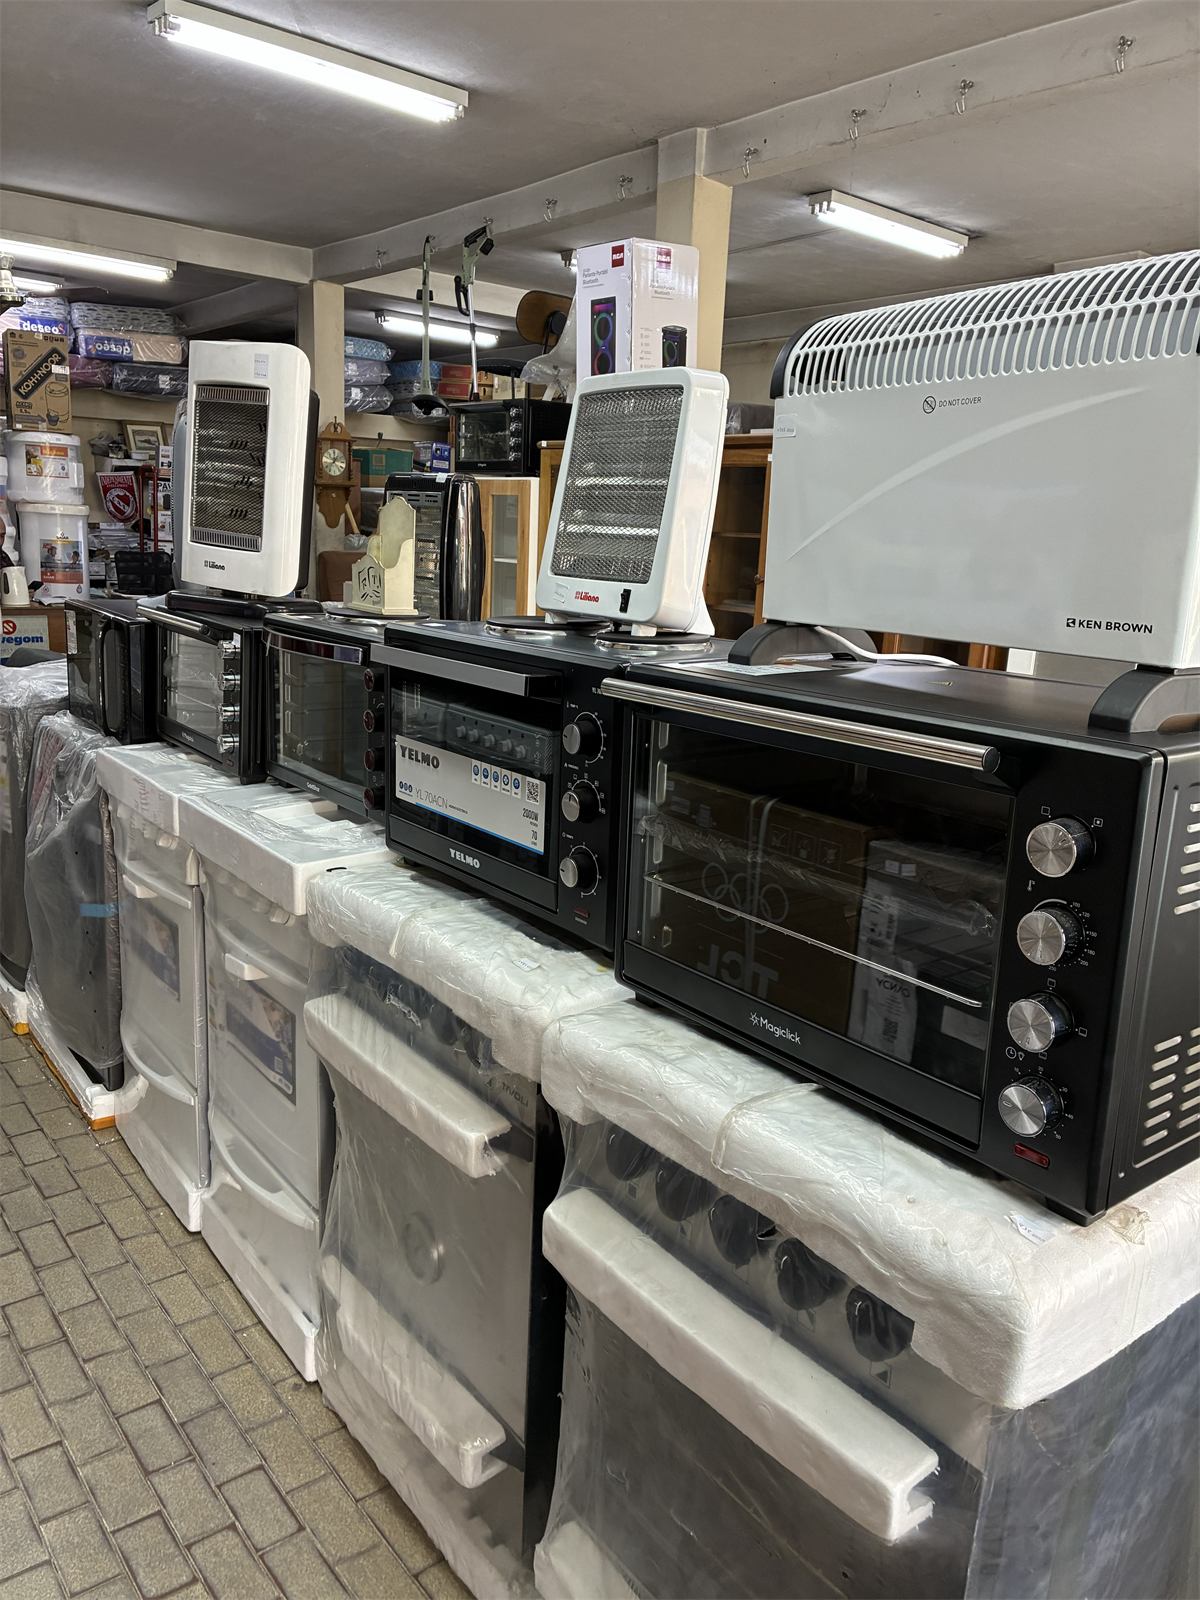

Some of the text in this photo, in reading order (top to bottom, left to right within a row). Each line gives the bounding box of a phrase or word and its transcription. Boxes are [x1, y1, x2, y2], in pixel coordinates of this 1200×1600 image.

[22, 320, 59, 334] deseo
[96, 342, 131, 356] deseo
[19, 353, 61, 395] KOH-I-NOOR
[961, 396, 981, 405] COVER
[209, 561, 225, 570] Liliana
[580, 591, 599, 602] Liliana
[1078, 619, 1153, 633] KEN BROWN
[400, 745, 440, 769] YELMO
[449, 848, 480, 869] YELMO
[760, 1018, 801, 1044] Magiclick
